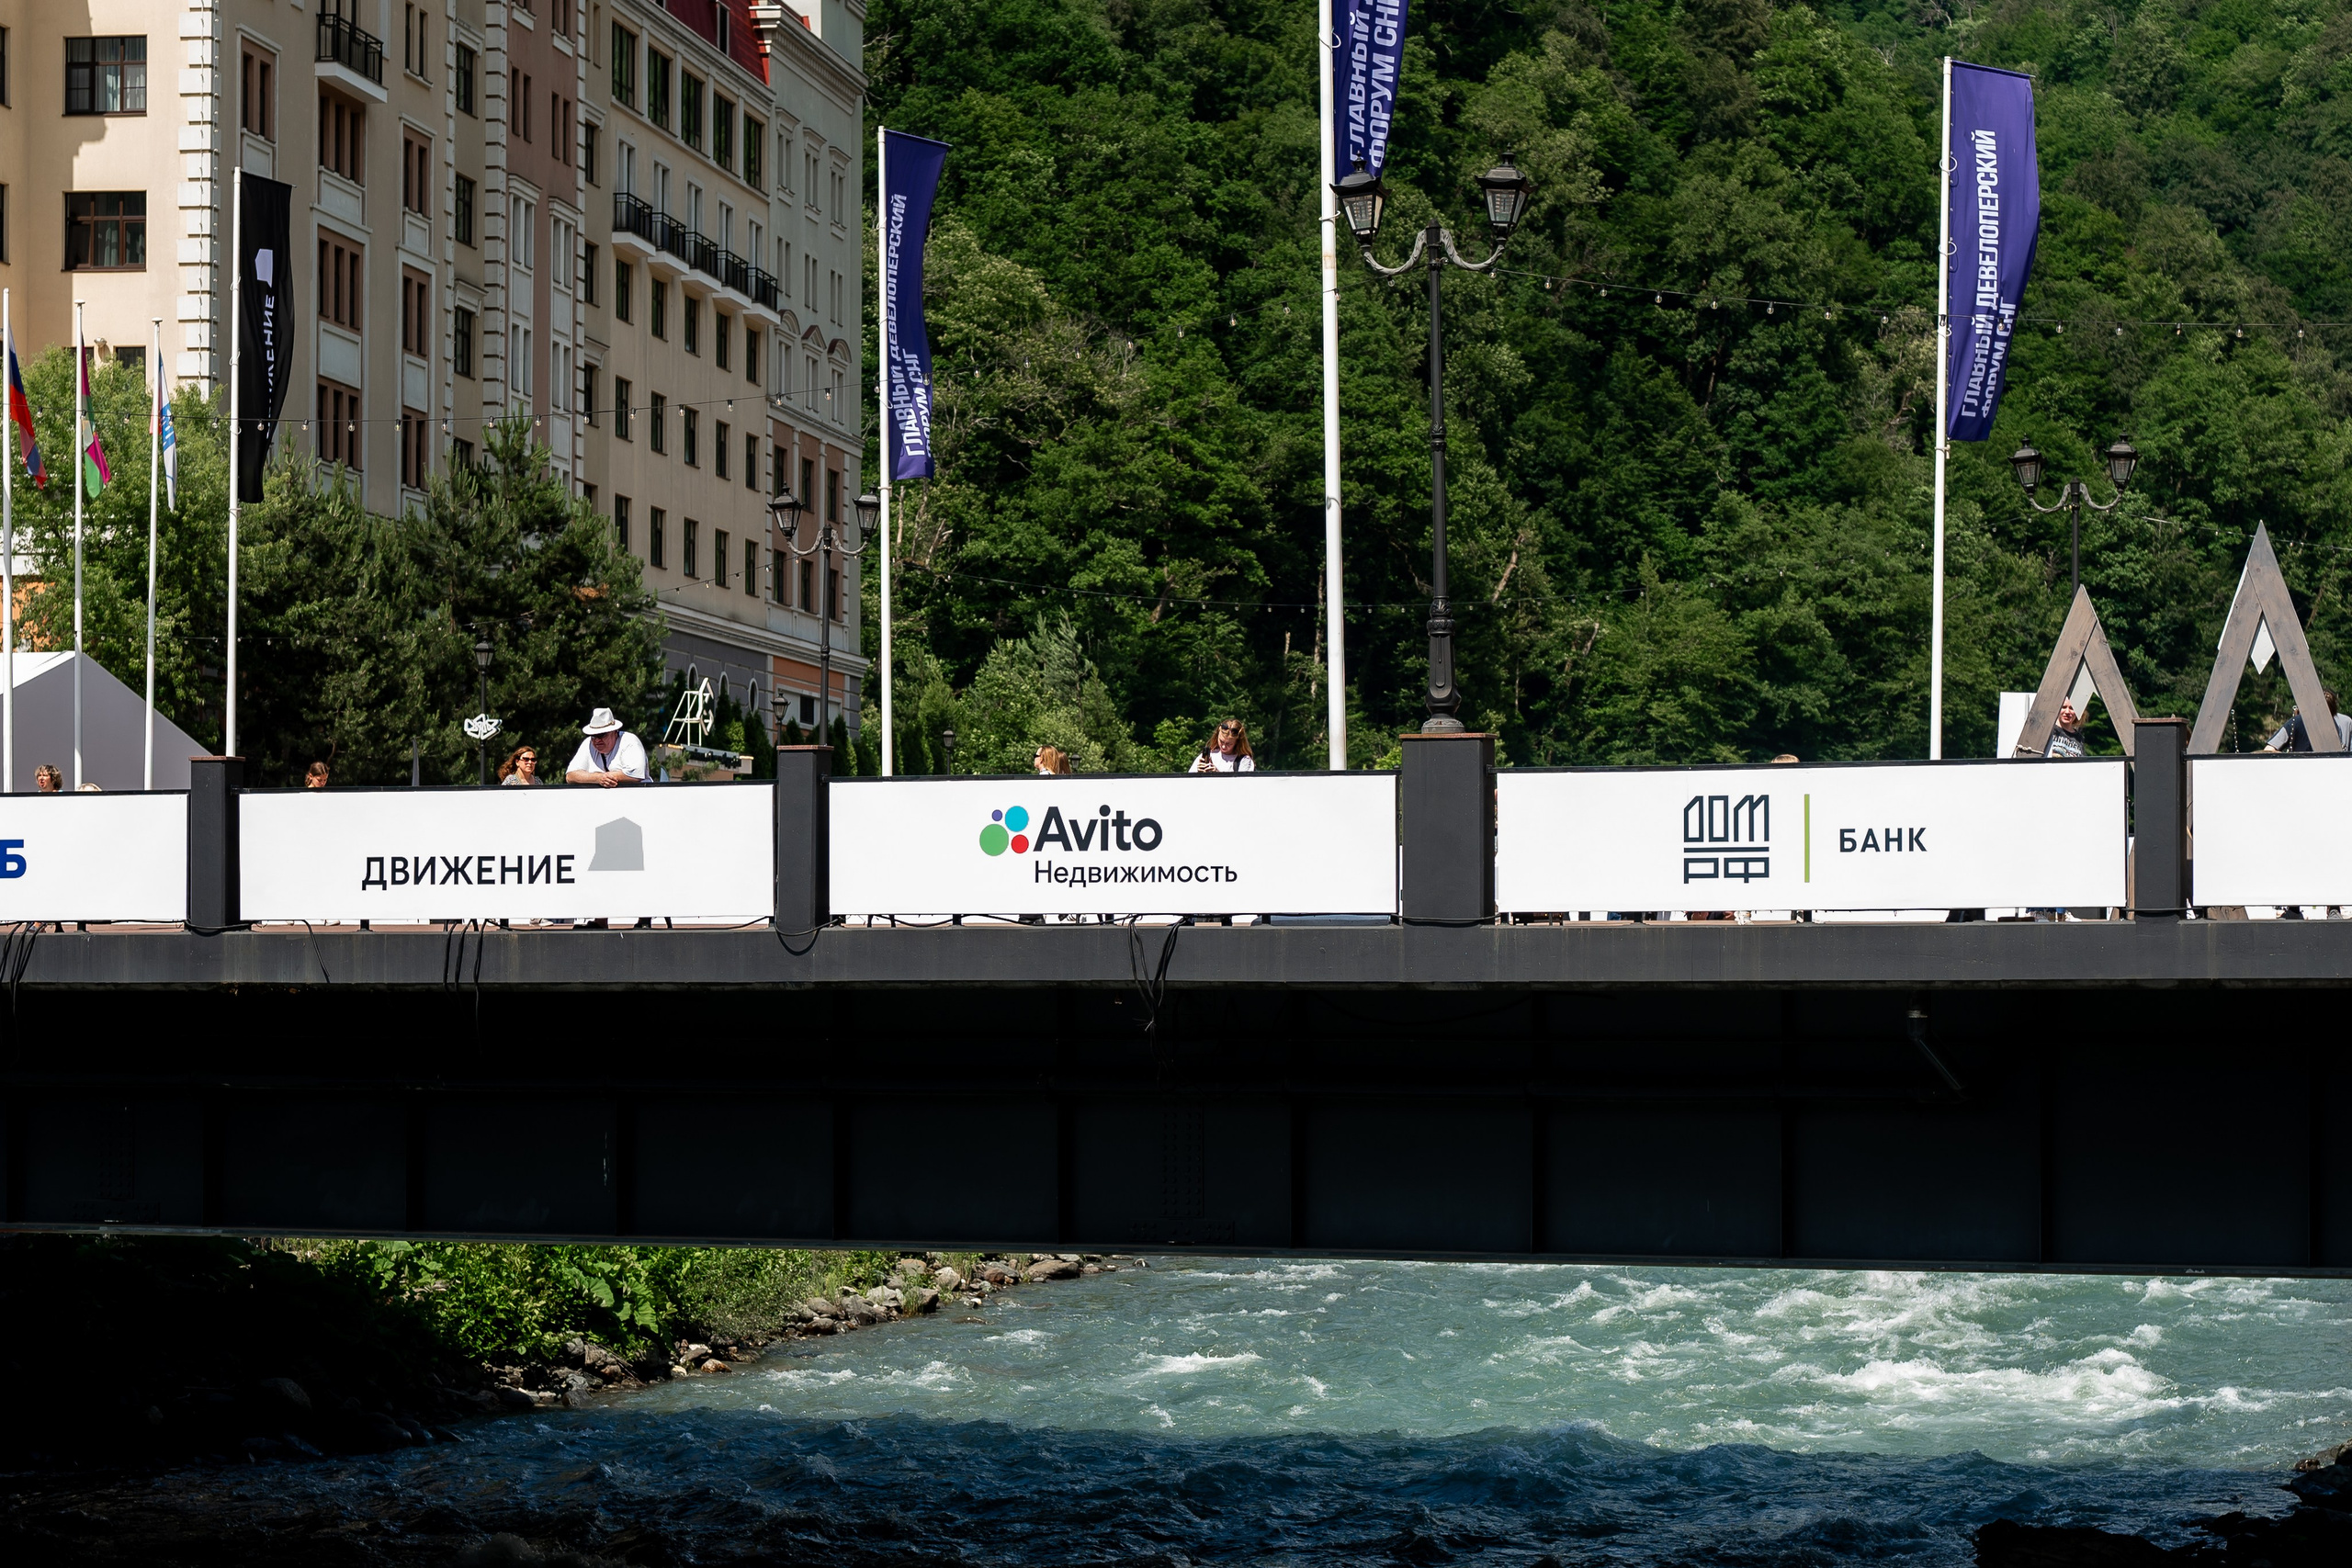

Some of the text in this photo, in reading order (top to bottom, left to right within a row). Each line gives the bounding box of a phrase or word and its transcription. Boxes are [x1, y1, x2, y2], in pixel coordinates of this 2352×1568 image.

[1349, 9, 1370, 162] ГЛАВНЫЙ
[1369, 52, 1396, 168] ФОРУМ
[1962, 130, 1999, 418] ГЛАВНЫЙ ДЕВЕЛОПЕРСКИЙ
[887, 193, 925, 457] ГЛАВНЫЙ ДЕВЕЛОПЕРСКИЙ
[902, 348, 923, 384] СНГ
[1982, 296, 2016, 419] ФОРУМ СНГ
[1034, 805, 1163, 852] Avito
[1683, 795, 1770, 842] ДОМ
[1839, 827, 1927, 852] БАНК
[362, 854, 576, 891] ДВИЖЕНИЕ
[1035, 861, 1238, 888] Недвижимость
[1683, 857, 1770, 884] РФ
